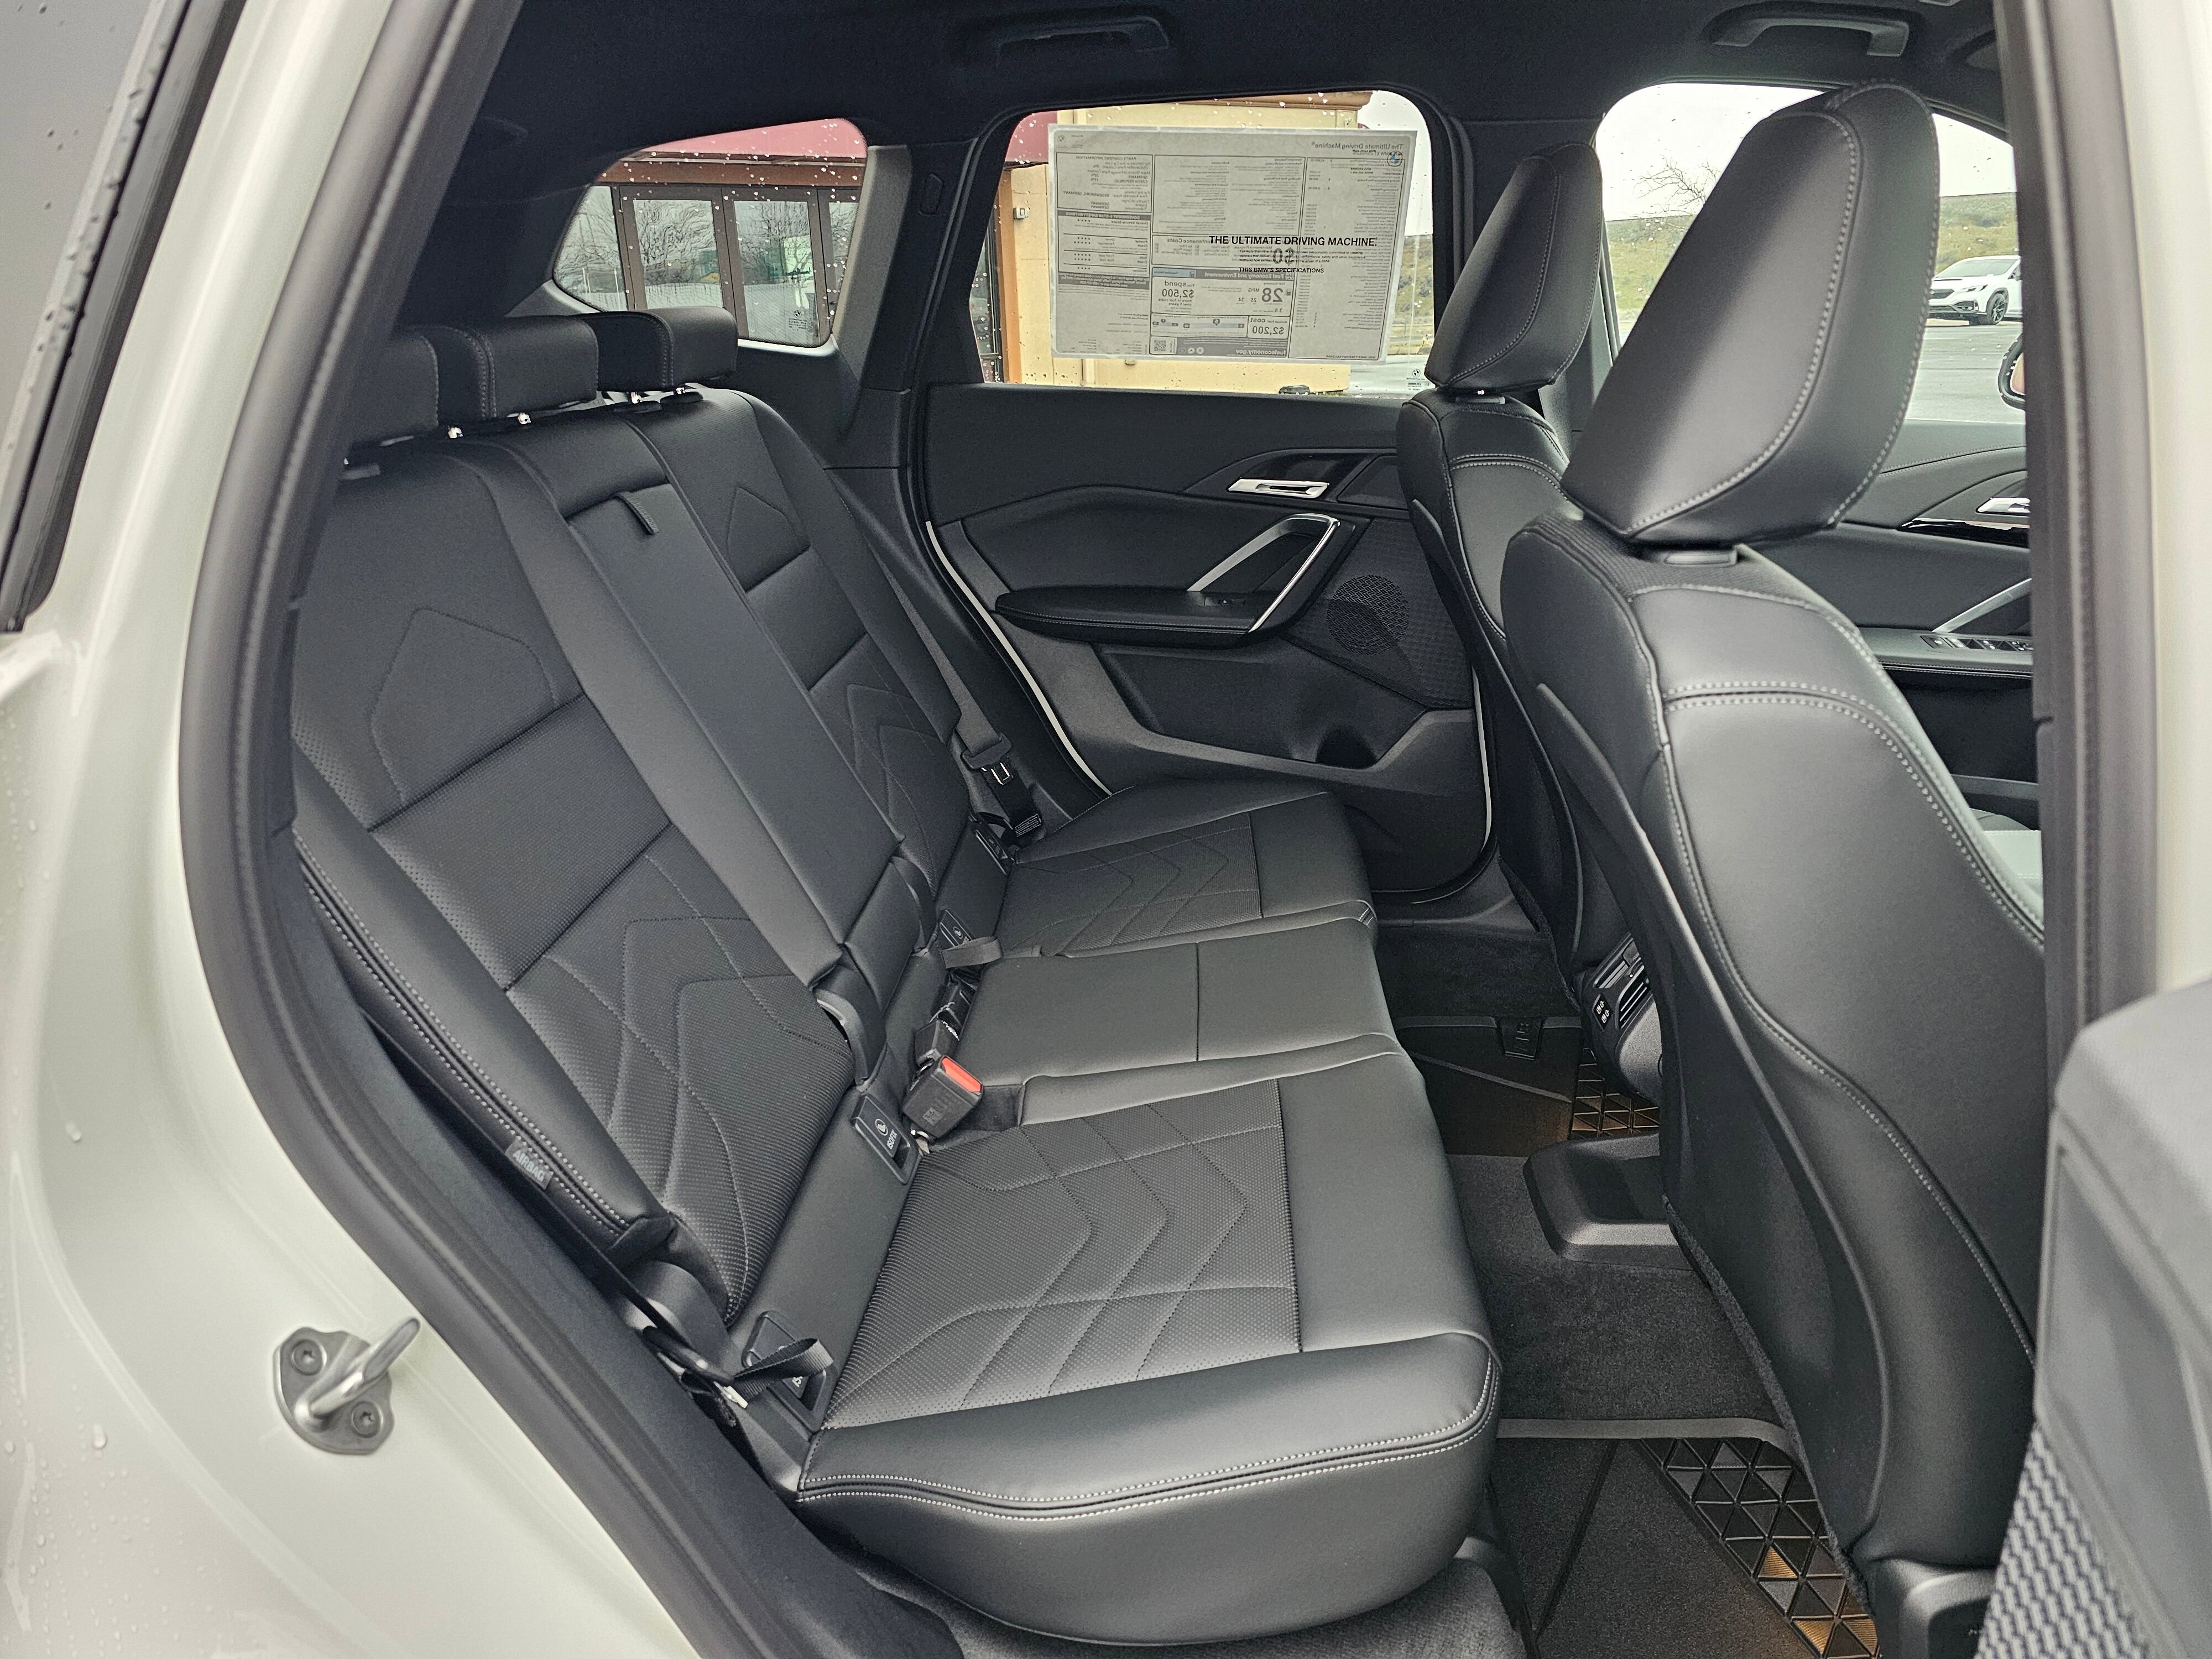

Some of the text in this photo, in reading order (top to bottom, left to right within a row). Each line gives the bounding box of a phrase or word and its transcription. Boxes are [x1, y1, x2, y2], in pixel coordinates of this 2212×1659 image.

[1209, 236, 1229, 244] THE
[1232, 236, 1281, 245] ULTIMATE
[1284, 237, 1325, 246] DRIVING
[886, 1129, 898, 1150] ISOFIX
[512, 1149, 546, 1182] AIRBAG
